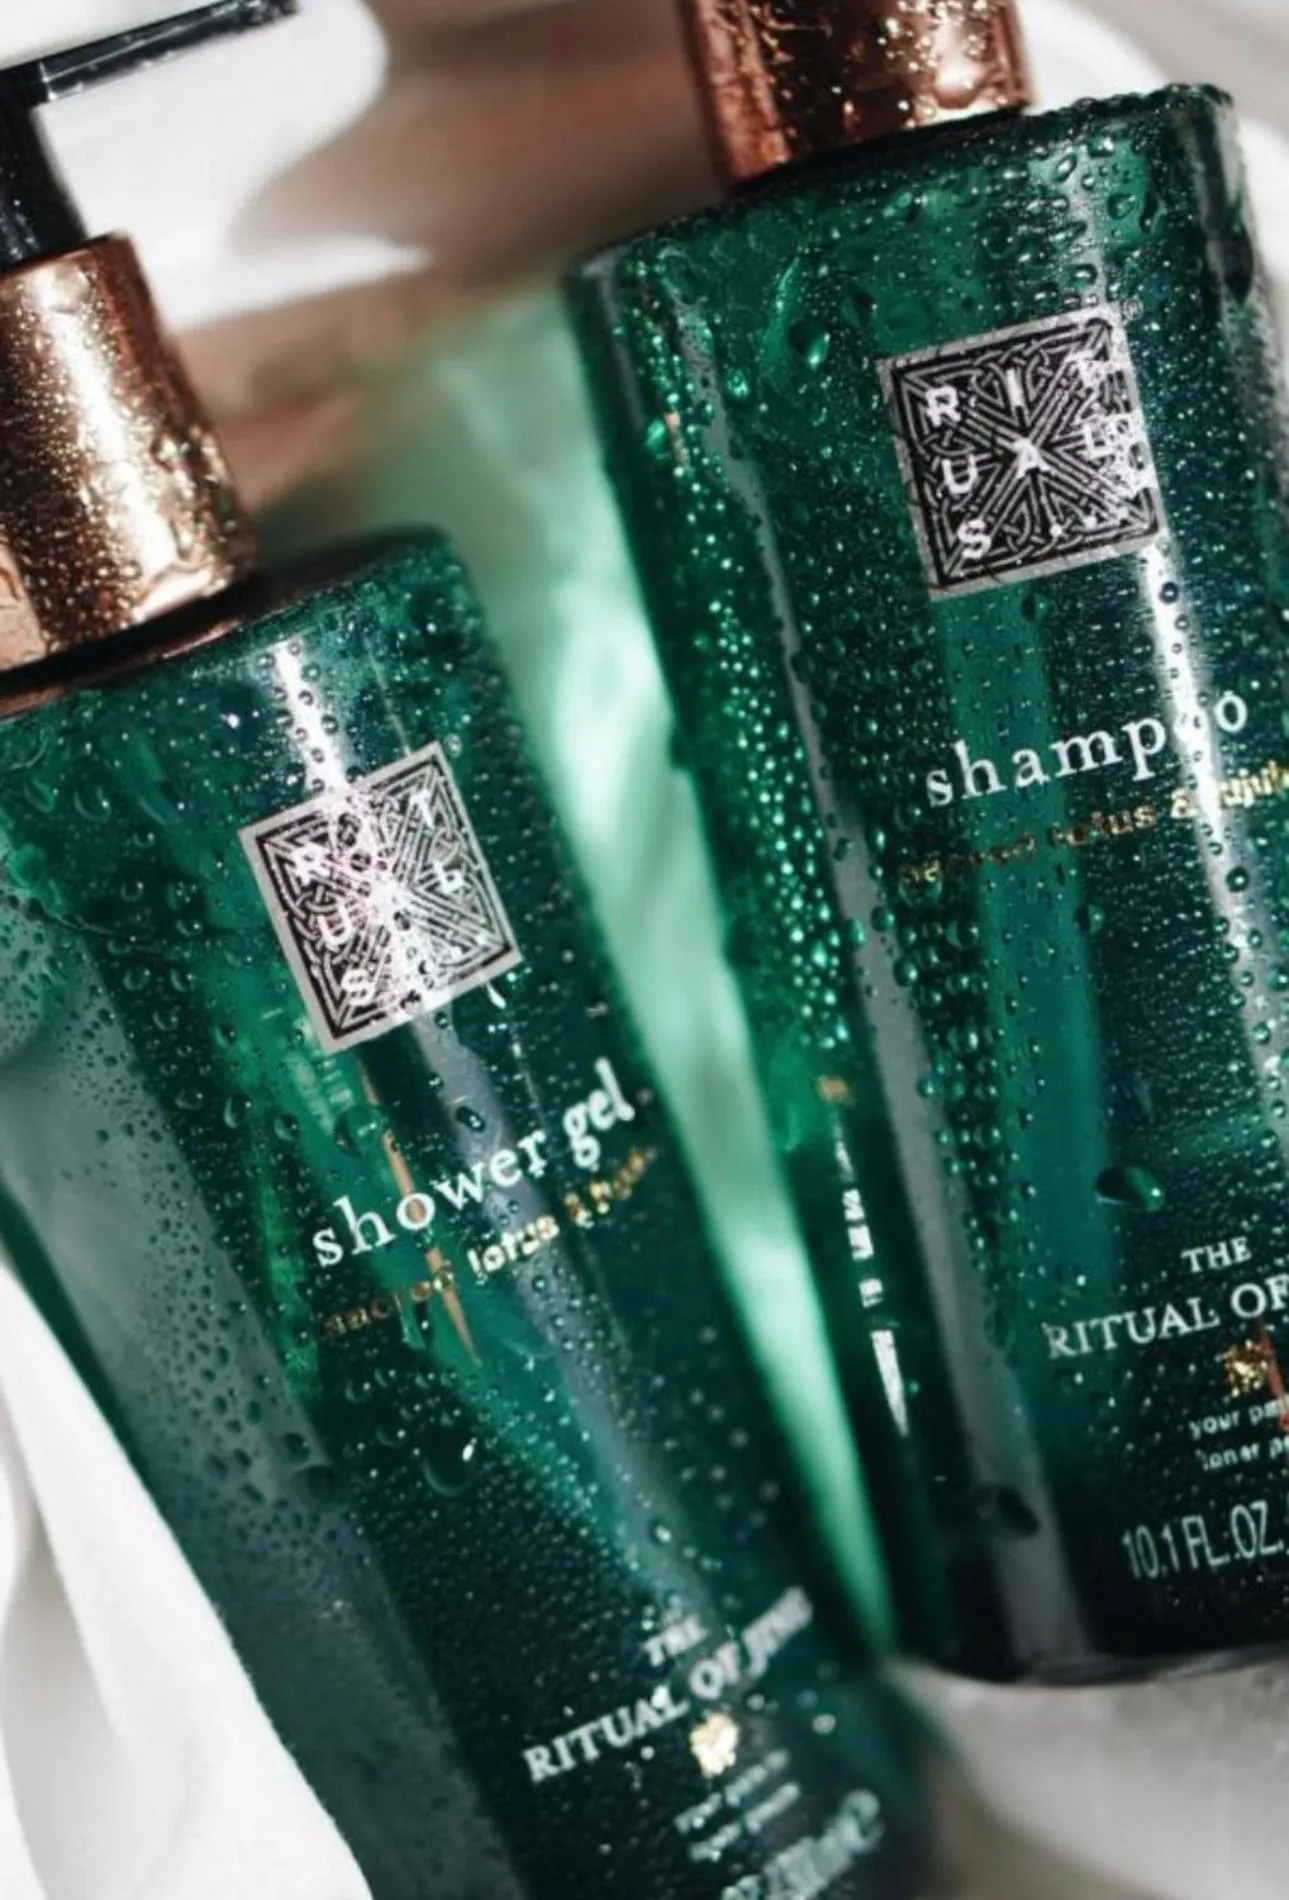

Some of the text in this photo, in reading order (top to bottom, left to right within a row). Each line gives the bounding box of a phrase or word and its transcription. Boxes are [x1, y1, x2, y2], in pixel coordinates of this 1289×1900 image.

[312, 1129, 547, 1266] shower
[563, 1057, 636, 1170] gel
[1180, 1236, 1252, 1274] THE
[1042, 1297, 1221, 1359] RITUAL
[523, 1688, 690, 1782] RITUAL
